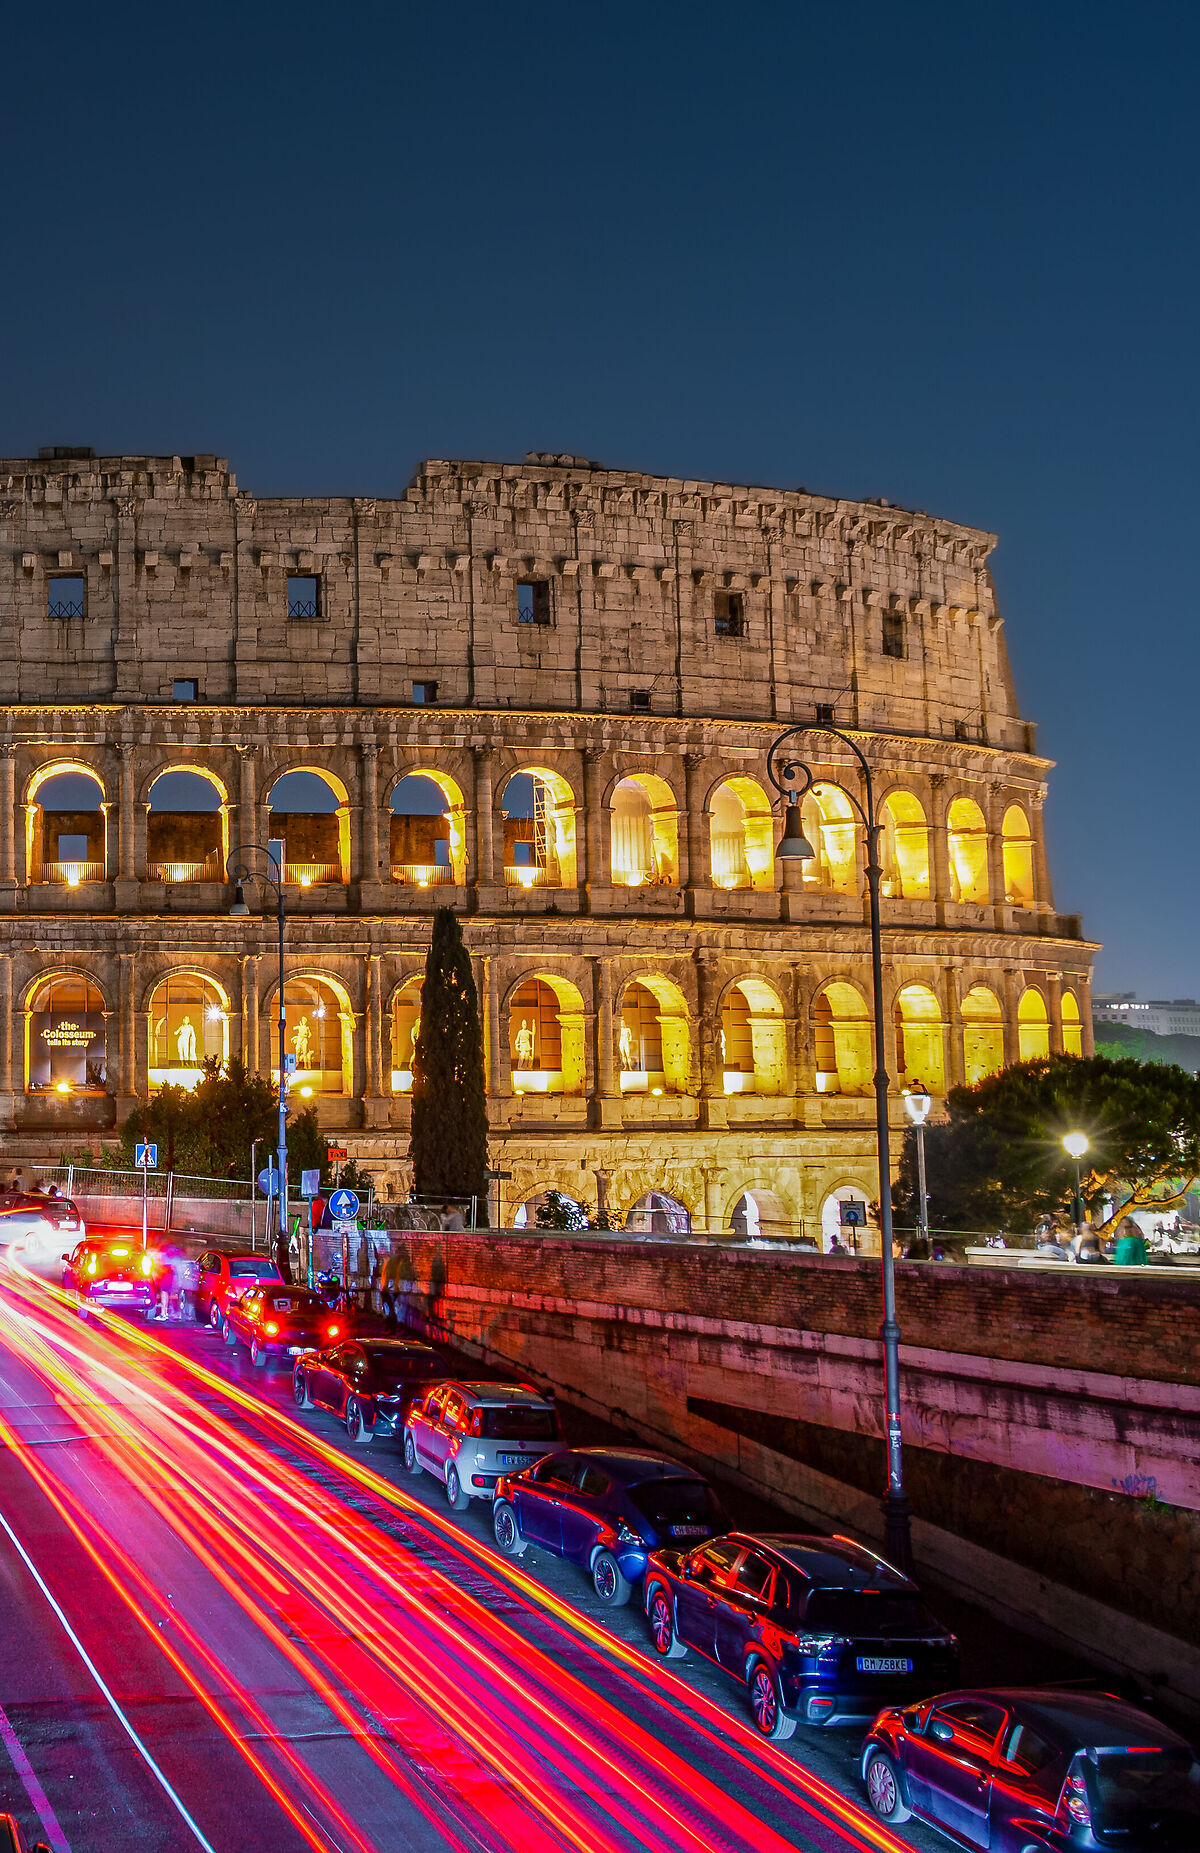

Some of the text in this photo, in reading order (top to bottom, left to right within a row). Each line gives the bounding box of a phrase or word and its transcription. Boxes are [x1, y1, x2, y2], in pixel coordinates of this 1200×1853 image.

[60, 1021, 77, 1031] the
[42, 1028, 94, 1039] Colosseum
[46, 1038, 89, 1048] tells its story
[864, 1658, 907, 1671] GM 758KE
